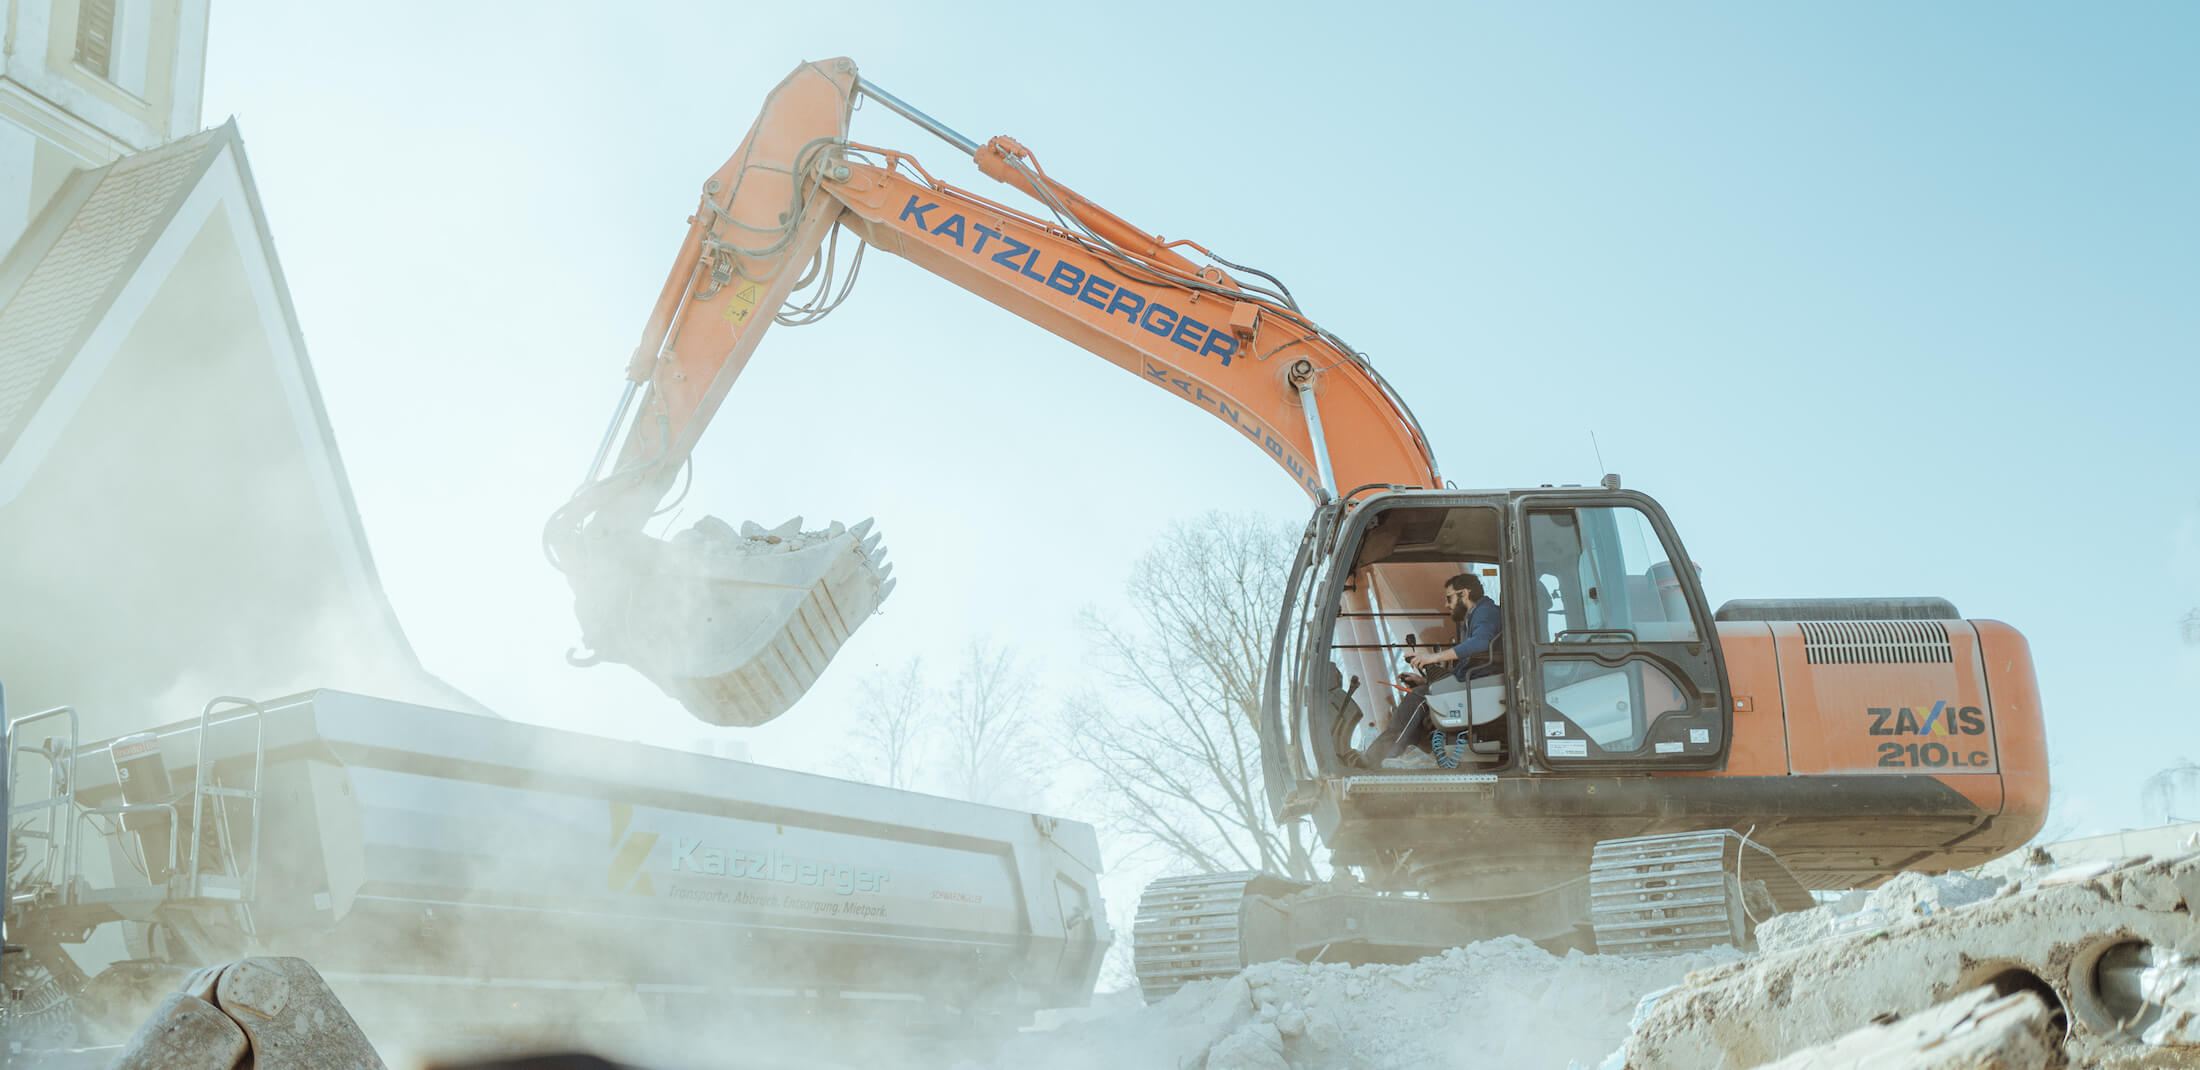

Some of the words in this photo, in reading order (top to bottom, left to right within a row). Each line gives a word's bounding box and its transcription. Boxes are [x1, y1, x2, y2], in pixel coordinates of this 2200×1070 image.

[899, 195, 1239, 367] KATZLBERGER
[1867, 700, 1985, 736] ZAXIS
[671, 836, 889, 895] Katzlberger
[843, 901, 888, 918] Mietpark.
